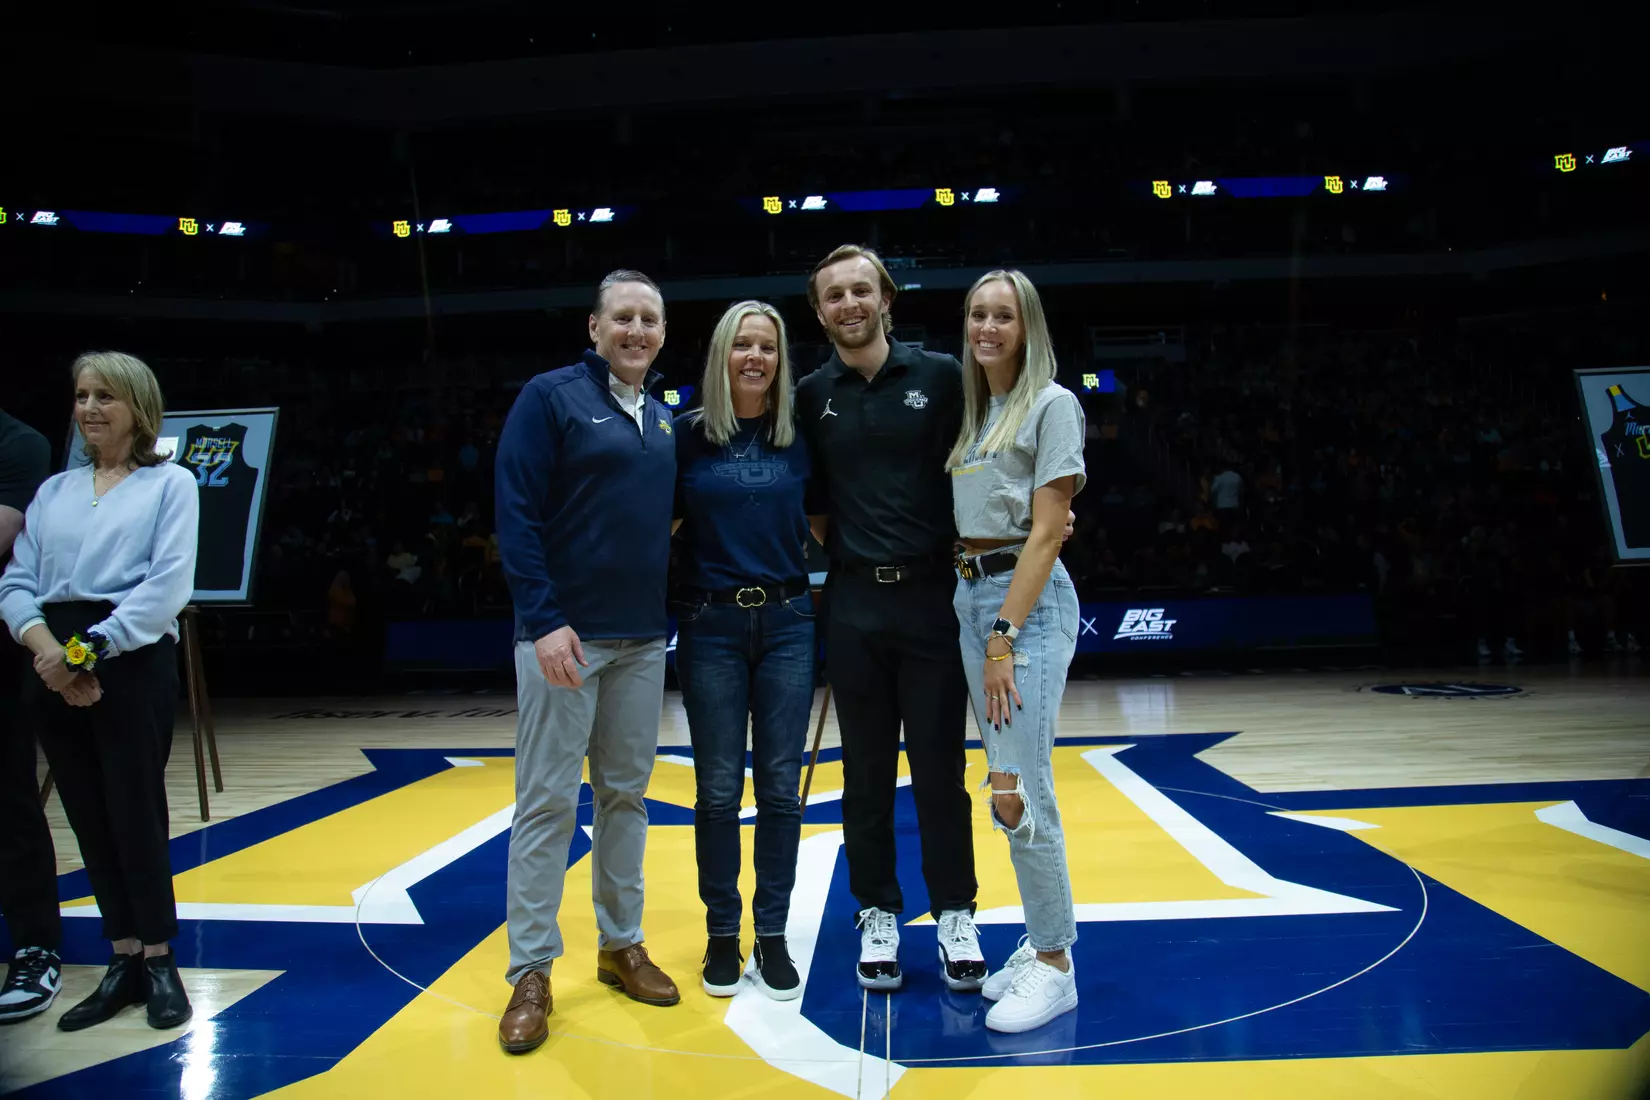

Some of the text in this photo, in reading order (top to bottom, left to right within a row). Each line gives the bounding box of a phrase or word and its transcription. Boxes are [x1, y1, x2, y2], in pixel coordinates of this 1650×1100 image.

[1554, 153, 1576, 172] MU
[1152, 180, 1171, 198] MU
[1324, 175, 1343, 193] MU
[763, 196, 782, 214] MU
[935, 187, 955, 206] MU
[553, 208, 571, 226] MU
[179, 218, 198, 235] MU
[393, 220, 410, 237] MU
[664, 390, 680, 405] MU
[191, 452, 233, 487] 32
[1124, 608, 1165, 621] BIG
[1118, 620, 1177, 633] EAST
